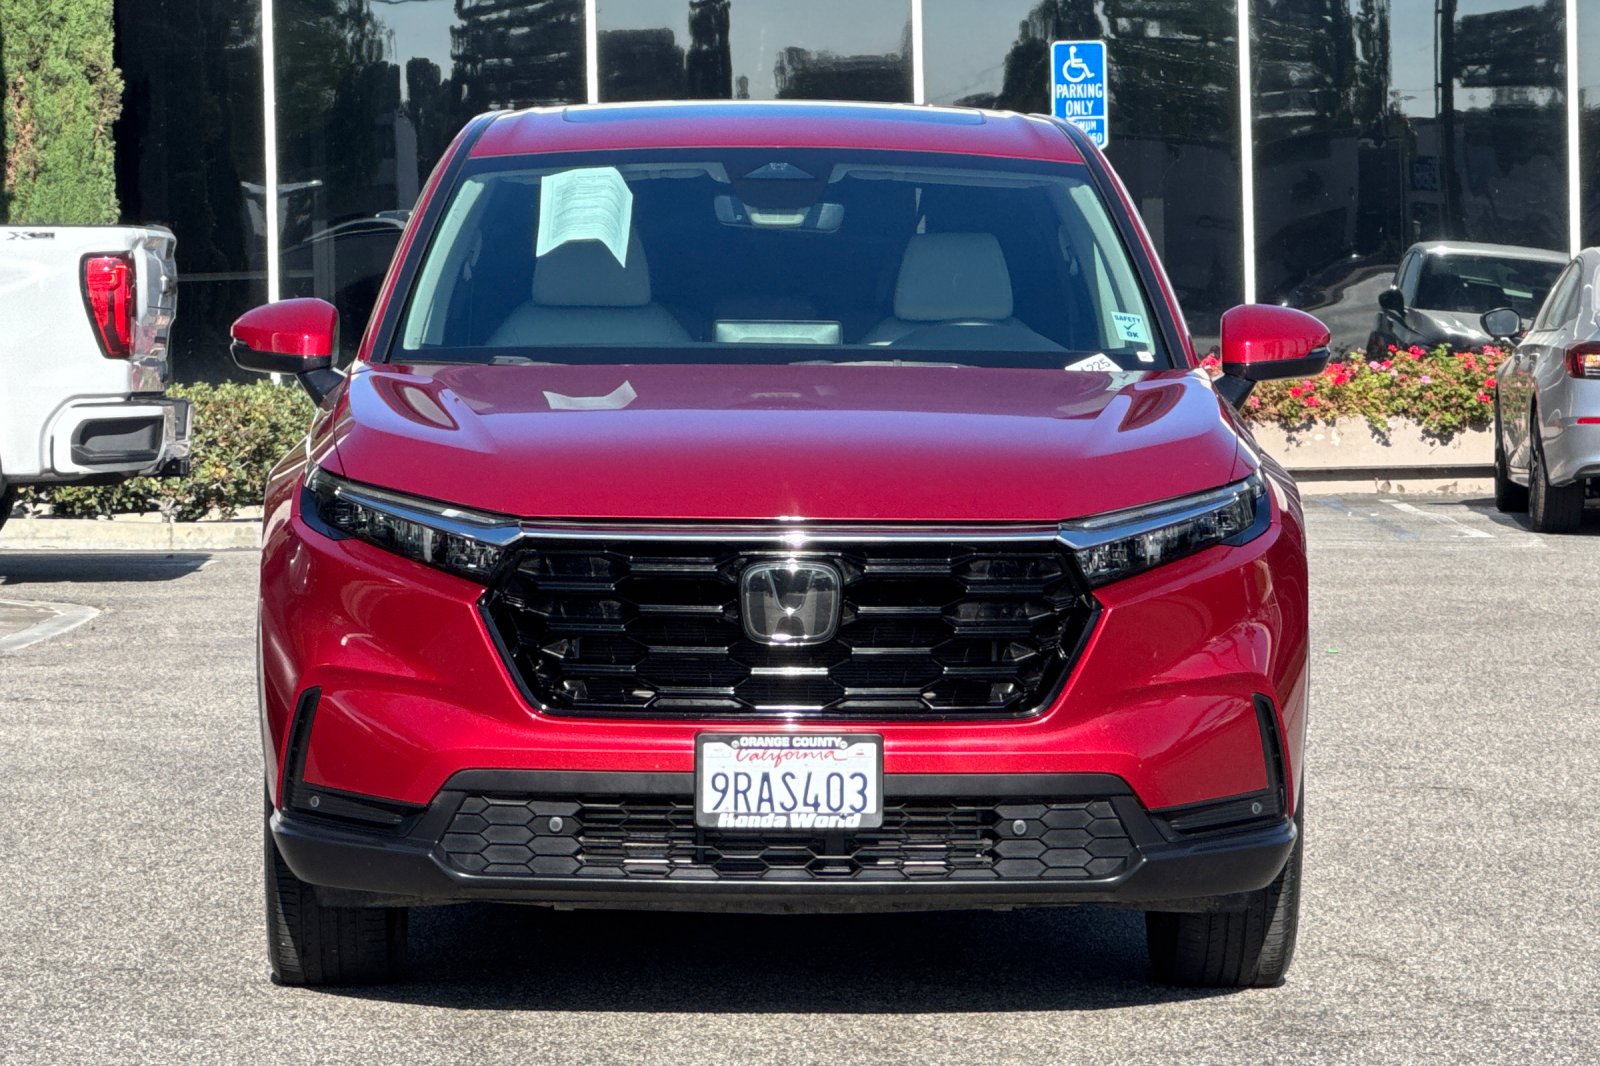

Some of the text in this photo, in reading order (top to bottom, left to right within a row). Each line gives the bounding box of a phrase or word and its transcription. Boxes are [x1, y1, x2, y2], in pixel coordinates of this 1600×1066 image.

[1056, 83, 1103, 99] PARKING
[1065, 100, 1094, 116] ONLY
[1114, 314, 1141, 322] SAFETY
[1081, 358, 1111, 371] 225
[739, 736, 842, 748] ORANGE COUNTY
[735, 748, 848, 768] California
[711, 771, 869, 813] 9RAS403
[717, 812, 863, 828] Honda World
